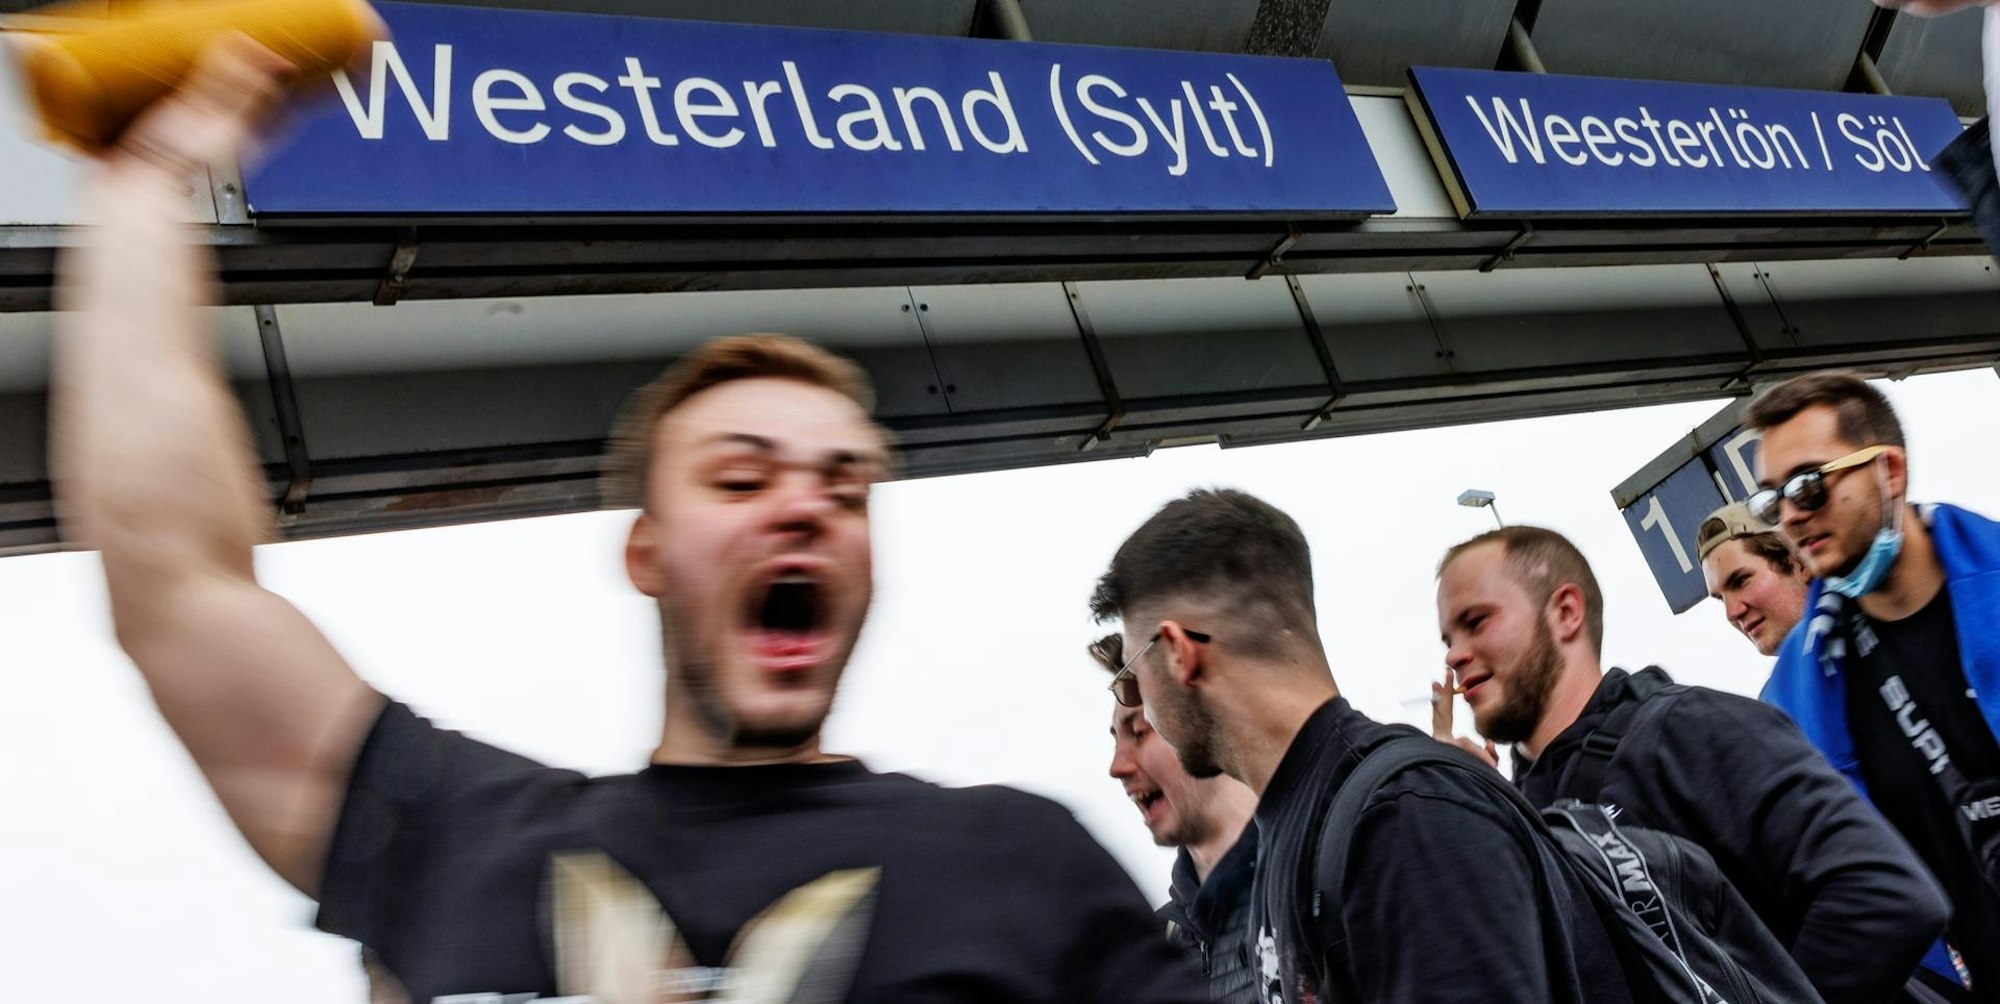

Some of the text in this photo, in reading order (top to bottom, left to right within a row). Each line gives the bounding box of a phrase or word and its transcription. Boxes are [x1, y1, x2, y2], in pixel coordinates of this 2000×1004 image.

[331, 40, 1274, 177] Westerland (Sylt)
[1465, 95, 1931, 173] Weesterlön / Söl
[1640, 495, 1694, 575] 1
[1588, 831, 1670, 941] IR MAX
